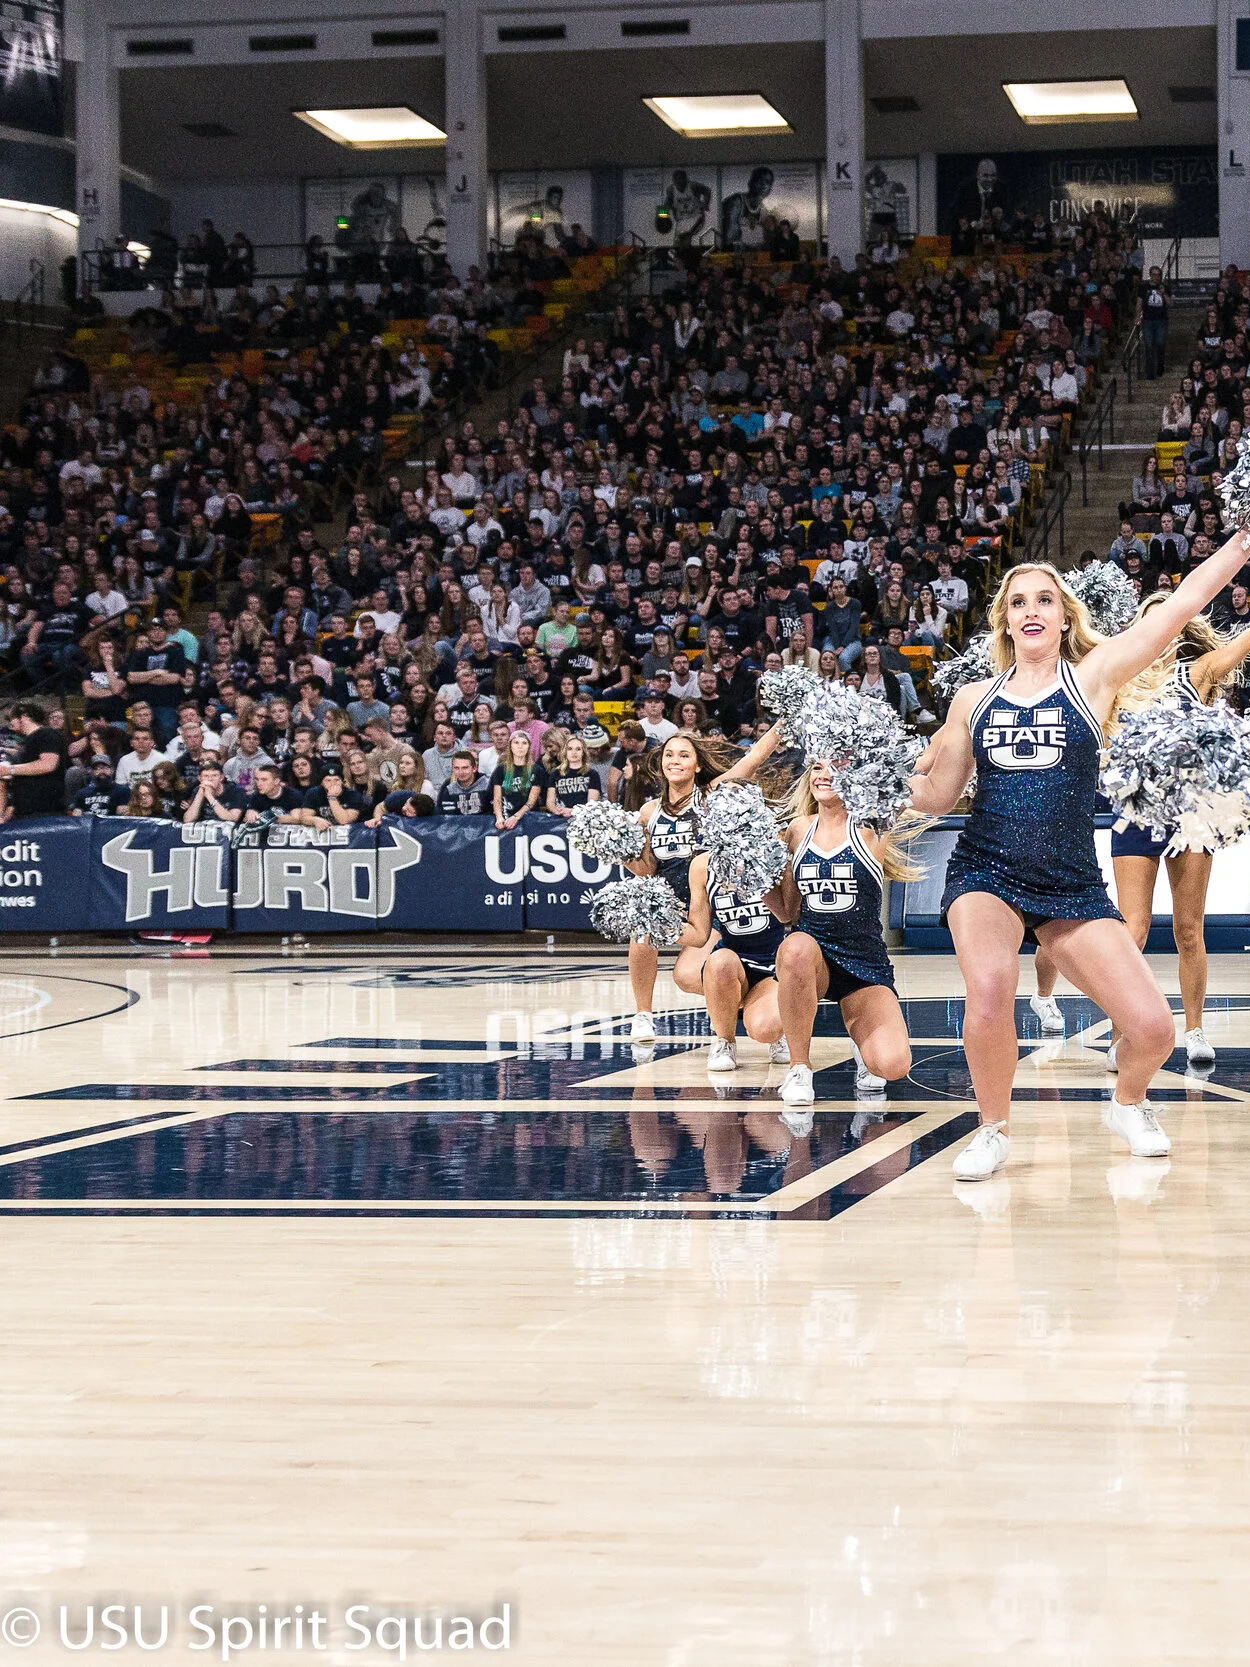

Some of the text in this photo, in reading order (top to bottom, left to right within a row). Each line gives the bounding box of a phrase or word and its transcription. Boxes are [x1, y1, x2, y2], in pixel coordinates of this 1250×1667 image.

[1229, 149, 1243, 168] L
[835, 161, 851, 180] K
[1151, 155, 1219, 184] STA
[454, 174, 468, 193] J
[83, 188, 98, 205] H
[982, 724, 1067, 750] STATE
[0, 839, 42, 863] dit
[102, 826, 422, 922] HURD
[797, 879, 859, 896] STATE
[715, 903, 771, 923] STATE
